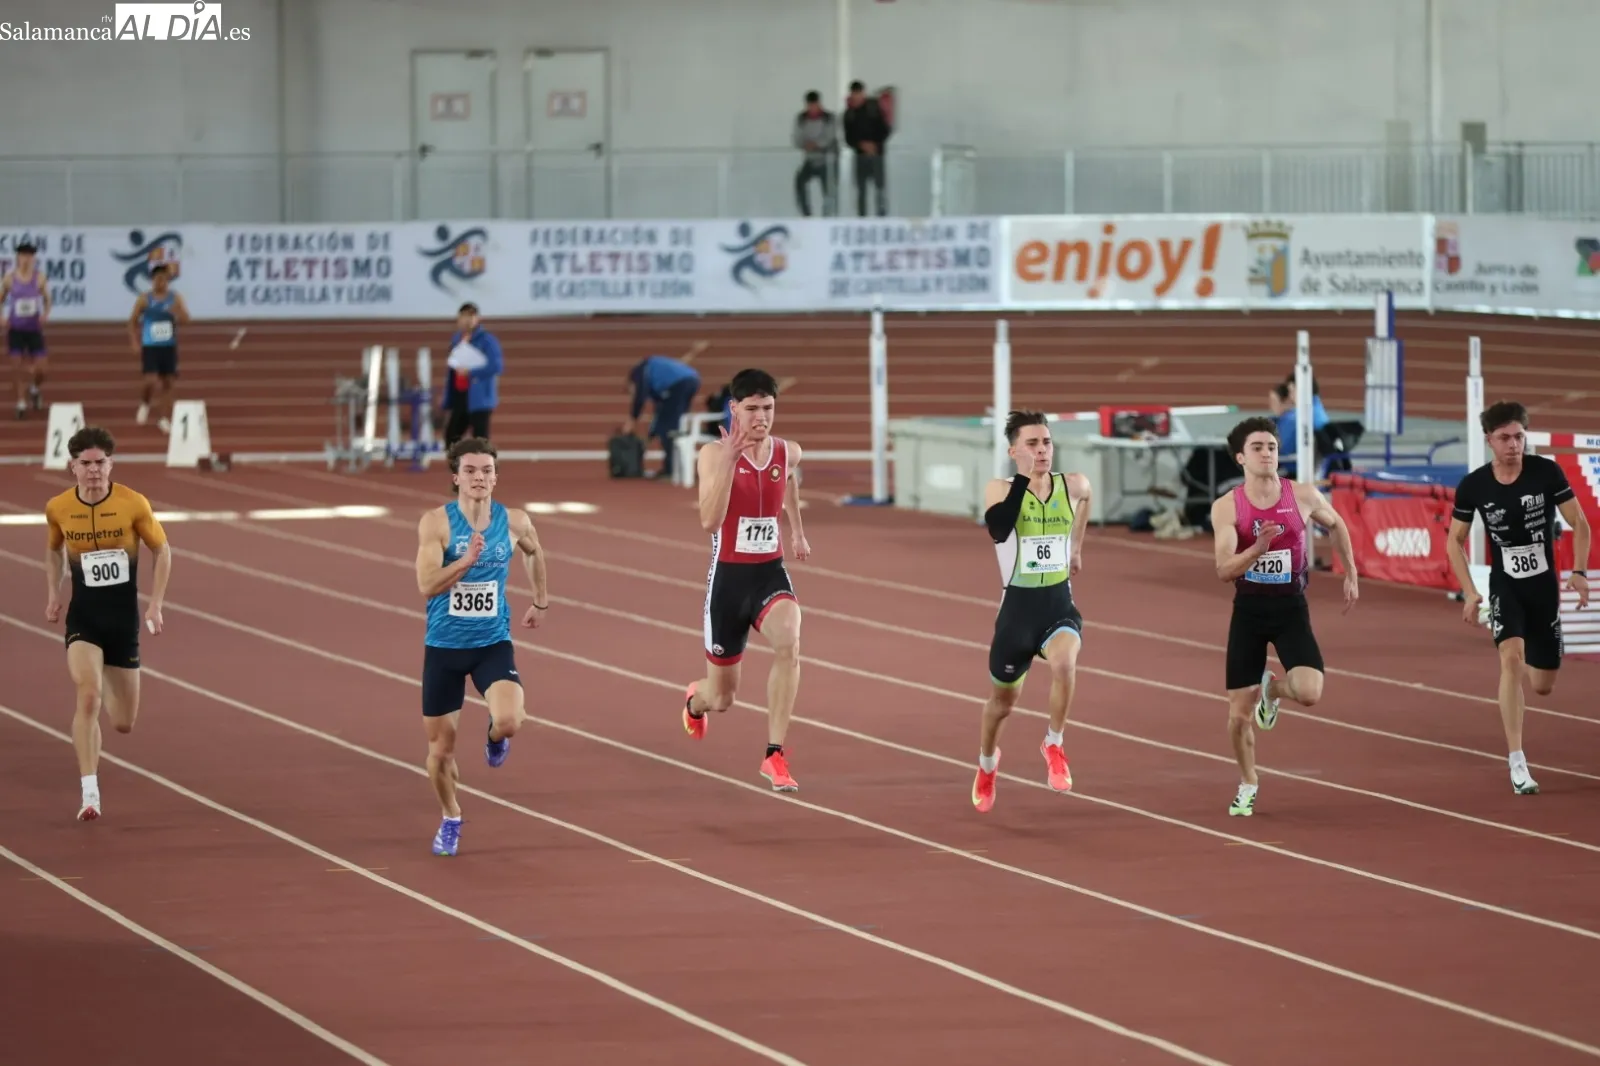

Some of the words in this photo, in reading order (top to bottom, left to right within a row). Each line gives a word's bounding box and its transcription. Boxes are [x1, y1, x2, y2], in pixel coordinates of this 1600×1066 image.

[61, 234, 85, 254] DE
[225, 231, 354, 253] FEDERACIÓN
[367, 231, 392, 252] DE
[530, 225, 658, 247] FEDERACIÓN
[670, 226, 694, 247] DE
[226, 256, 392, 281] ATLETISMO
[530, 252, 694, 275] ATLETISMO
[830, 246, 991, 273] ATLETISMO
[1015, 222, 1222, 298] enjoy!
[1300, 247, 1426, 272] Ayuntamiento
[1519, 262, 1538, 276] de
[1300, 274, 1320, 294] de
[1327, 273, 1425, 294] Salamanca
[226, 285, 247, 306] DE
[251, 285, 331, 305] CASTILLA
[333, 285, 344, 303] Y
[180, 414, 189, 441] 1
[52, 428, 63, 458] 2
[66, 528, 124, 543] Norpetrol
[745, 525, 774, 541] 1712
[1036, 544, 1051, 560] 66
[92, 562, 119, 581] 900
[1511, 553, 1538, 574] 386
[453, 592, 494, 612] 3365
